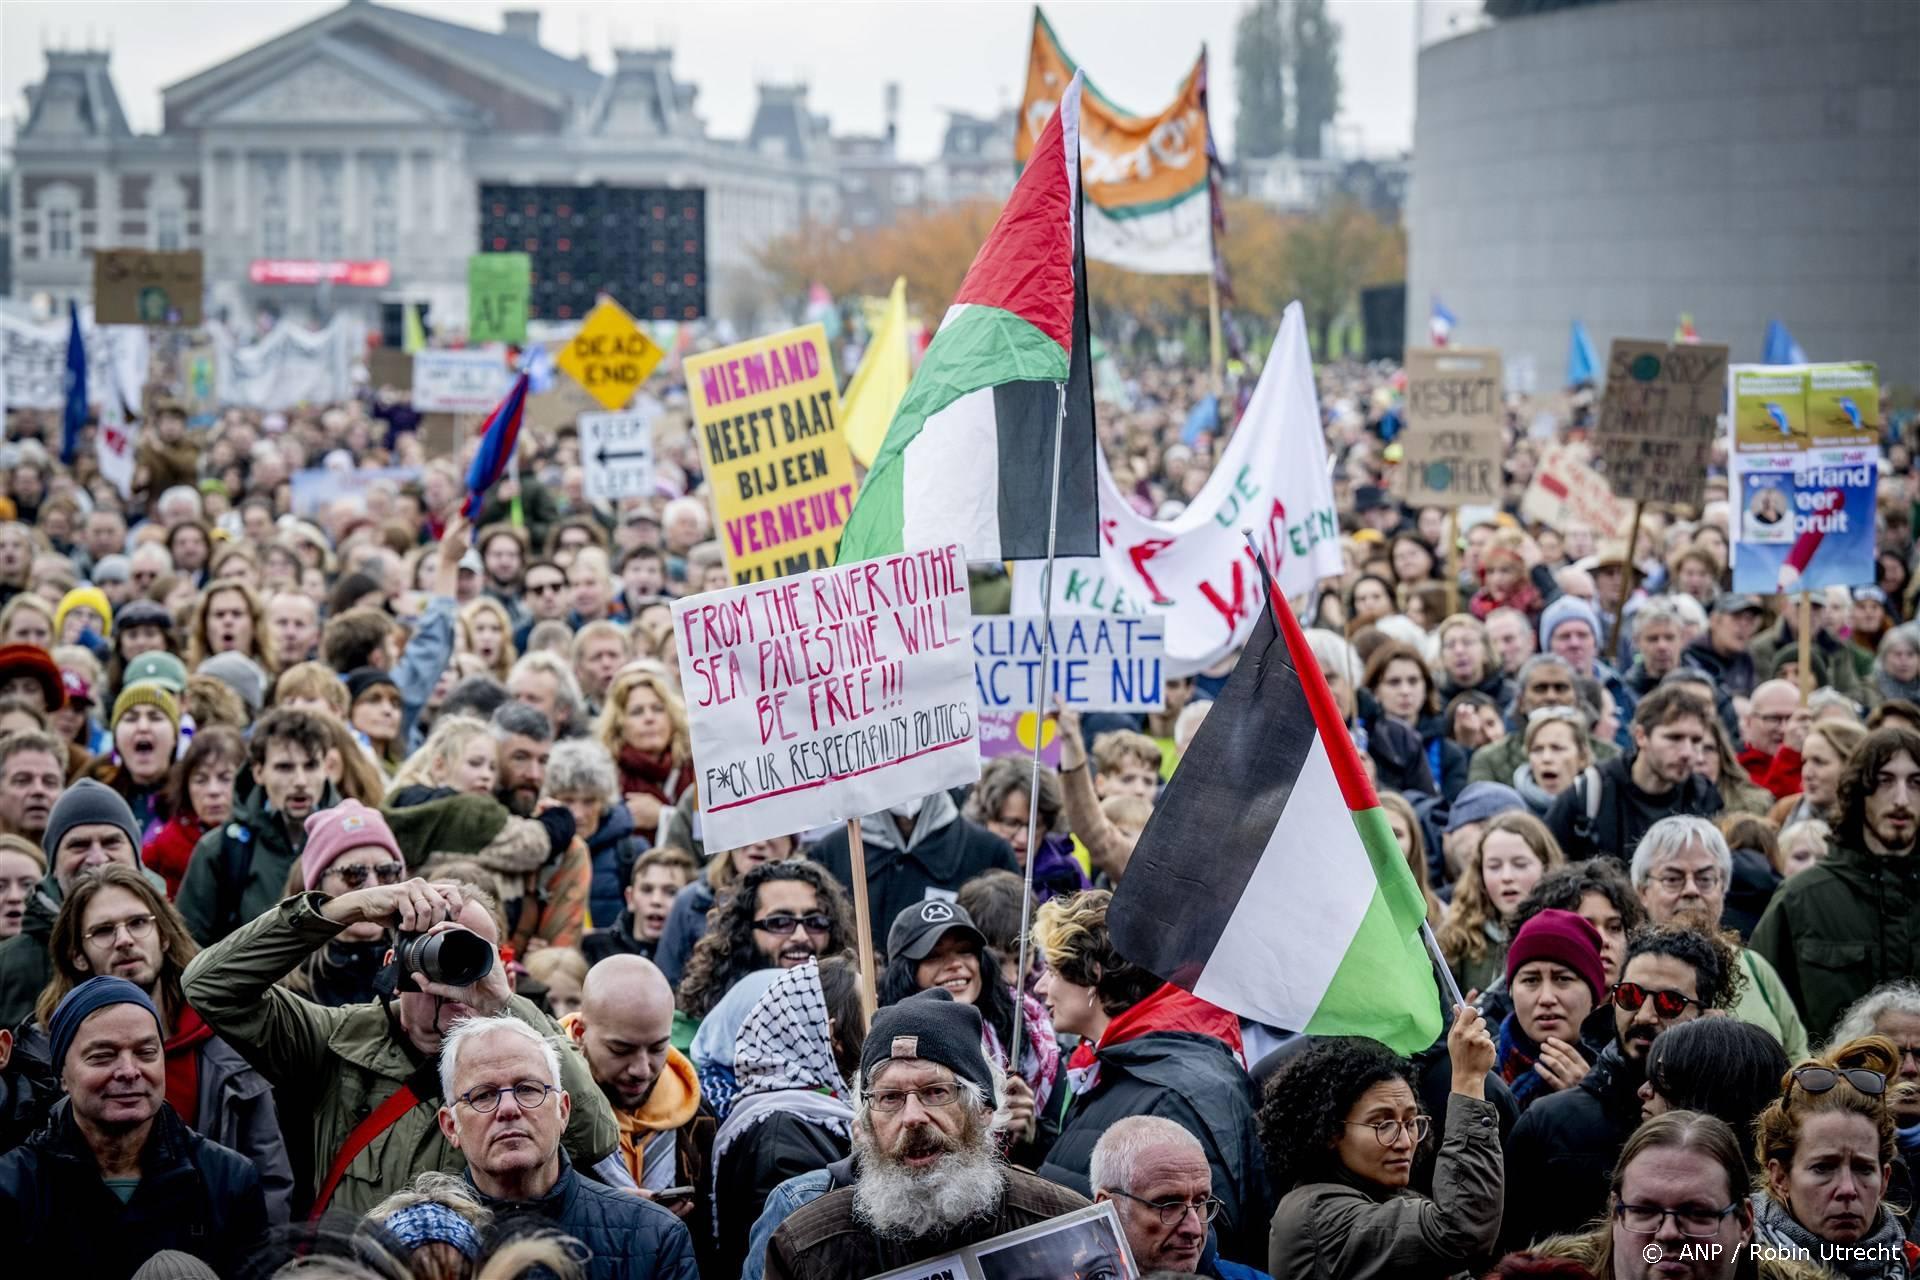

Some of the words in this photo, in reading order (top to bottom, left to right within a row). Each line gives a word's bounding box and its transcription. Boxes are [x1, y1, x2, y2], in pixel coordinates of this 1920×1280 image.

[574, 334, 645, 359] DEAD
[583, 363, 640, 386] END
[700, 340, 820, 407] NIEMAND
[592, 414, 641, 441] KEEP
[705, 405, 777, 465] HEEFT
[779, 390, 835, 444] BAAT
[1409, 376, 1496, 420] RESPECT
[593, 467, 645, 495] LEFT
[725, 484, 853, 558] VERNEUKT
[683, 594, 755, 656] FROM
[756, 582, 809, 637] THE
[812, 562, 891, 624] RIVER
[693, 650, 748, 707] SEA
[758, 614, 887, 691] PALESTINE
[894, 600, 960, 655] WILL
[1112, 657, 1161, 705] NU
[755, 690, 797, 745] BE
[808, 660, 904, 731] FREE!!!
[756, 752, 785, 791] UR
[788, 716, 907, 785] RESPECTABILITY
[913, 702, 972, 748] POLITICS
